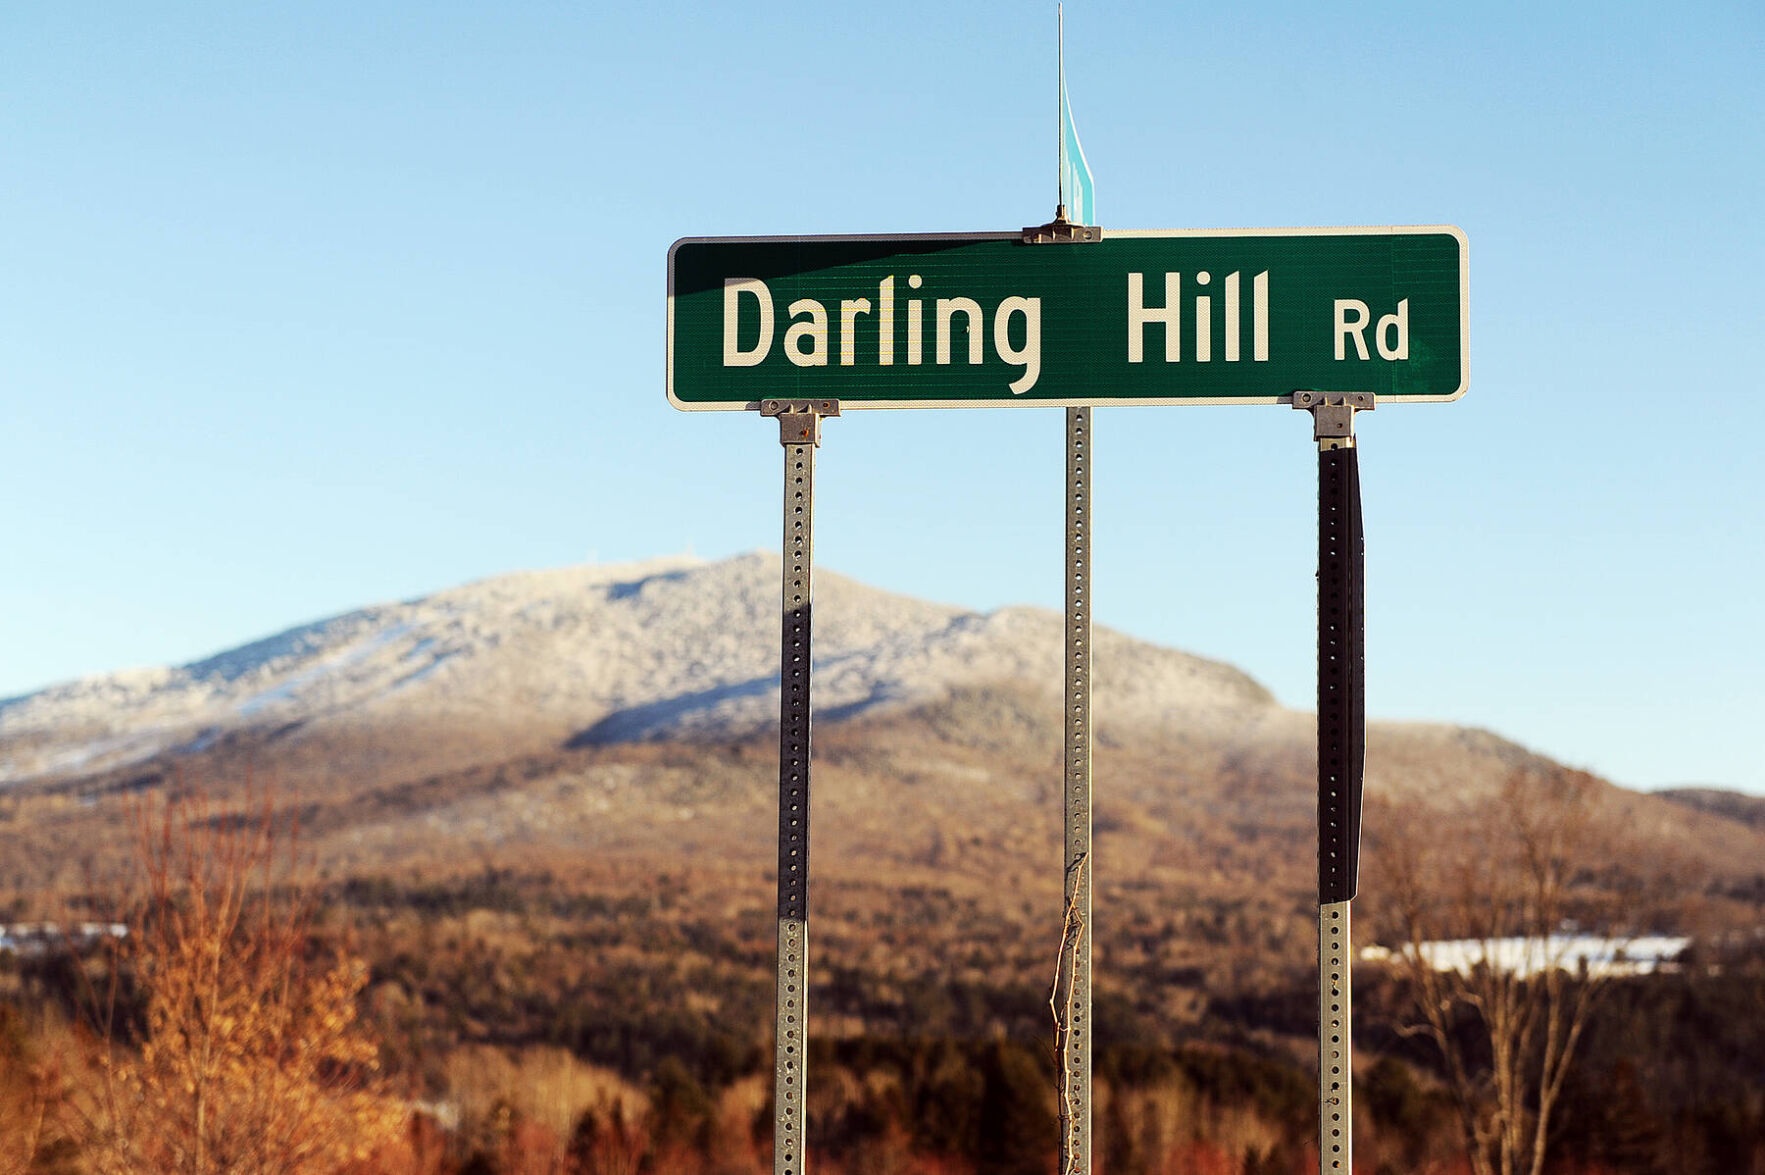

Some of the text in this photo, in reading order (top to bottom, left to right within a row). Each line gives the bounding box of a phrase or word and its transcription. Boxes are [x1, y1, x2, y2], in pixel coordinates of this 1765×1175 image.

[722, 269, 1410, 395] Darling Hill Rd
